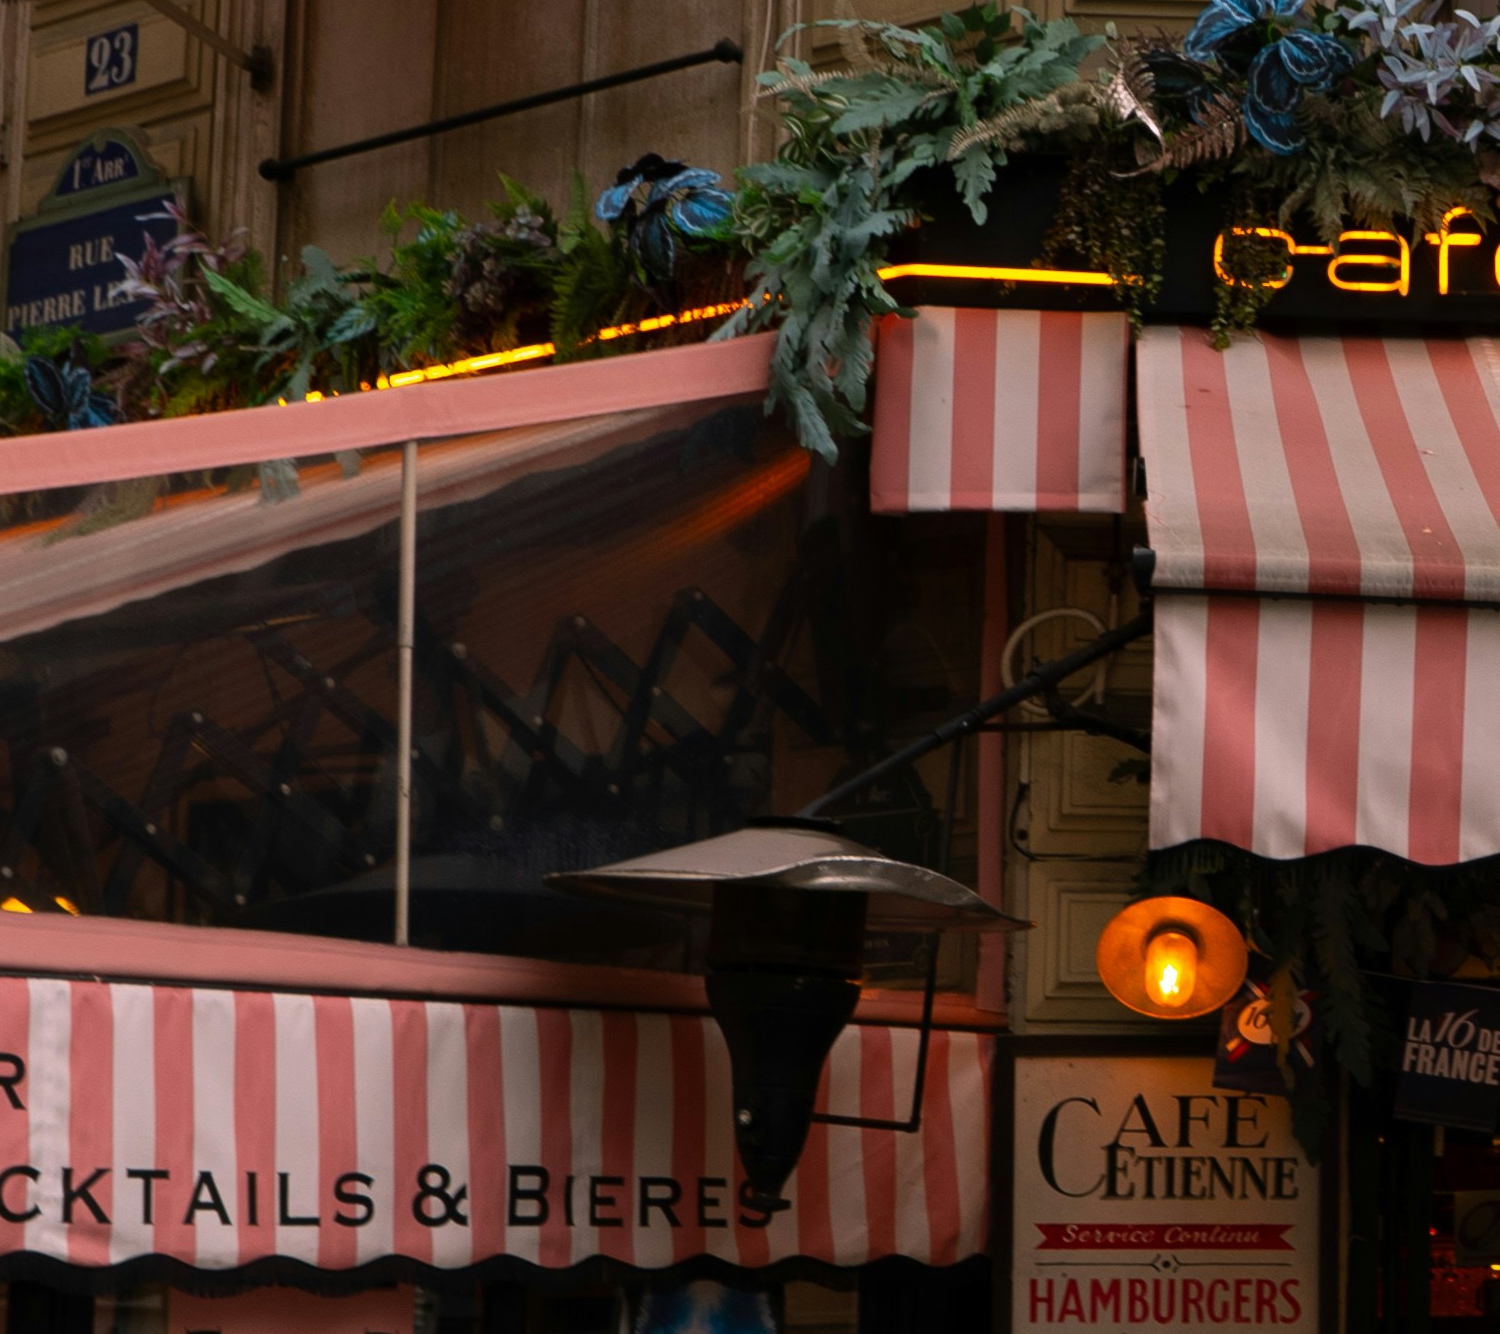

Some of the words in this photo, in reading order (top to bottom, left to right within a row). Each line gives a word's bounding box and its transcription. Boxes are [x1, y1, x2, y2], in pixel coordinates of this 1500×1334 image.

[89, 31, 134, 91] 23
[69, 235, 114, 270] RUE
[8, 288, 87, 332] PIERRE
[1408, 1017, 1432, 1043] LA
[1433, 1008, 1481, 1048] 16
[1402, 1041, 1500, 1086] FRANCE
[411, 1161, 470, 1228] &
[508, 1162, 776, 1229] BIERES
[1100, 1144, 1298, 1201] ETIENNE
[1062, 1224, 1155, 1244] Service
[1164, 1224, 1263, 1244] Continu
[1028, 1278, 1301, 1324] HAMBURGERS
